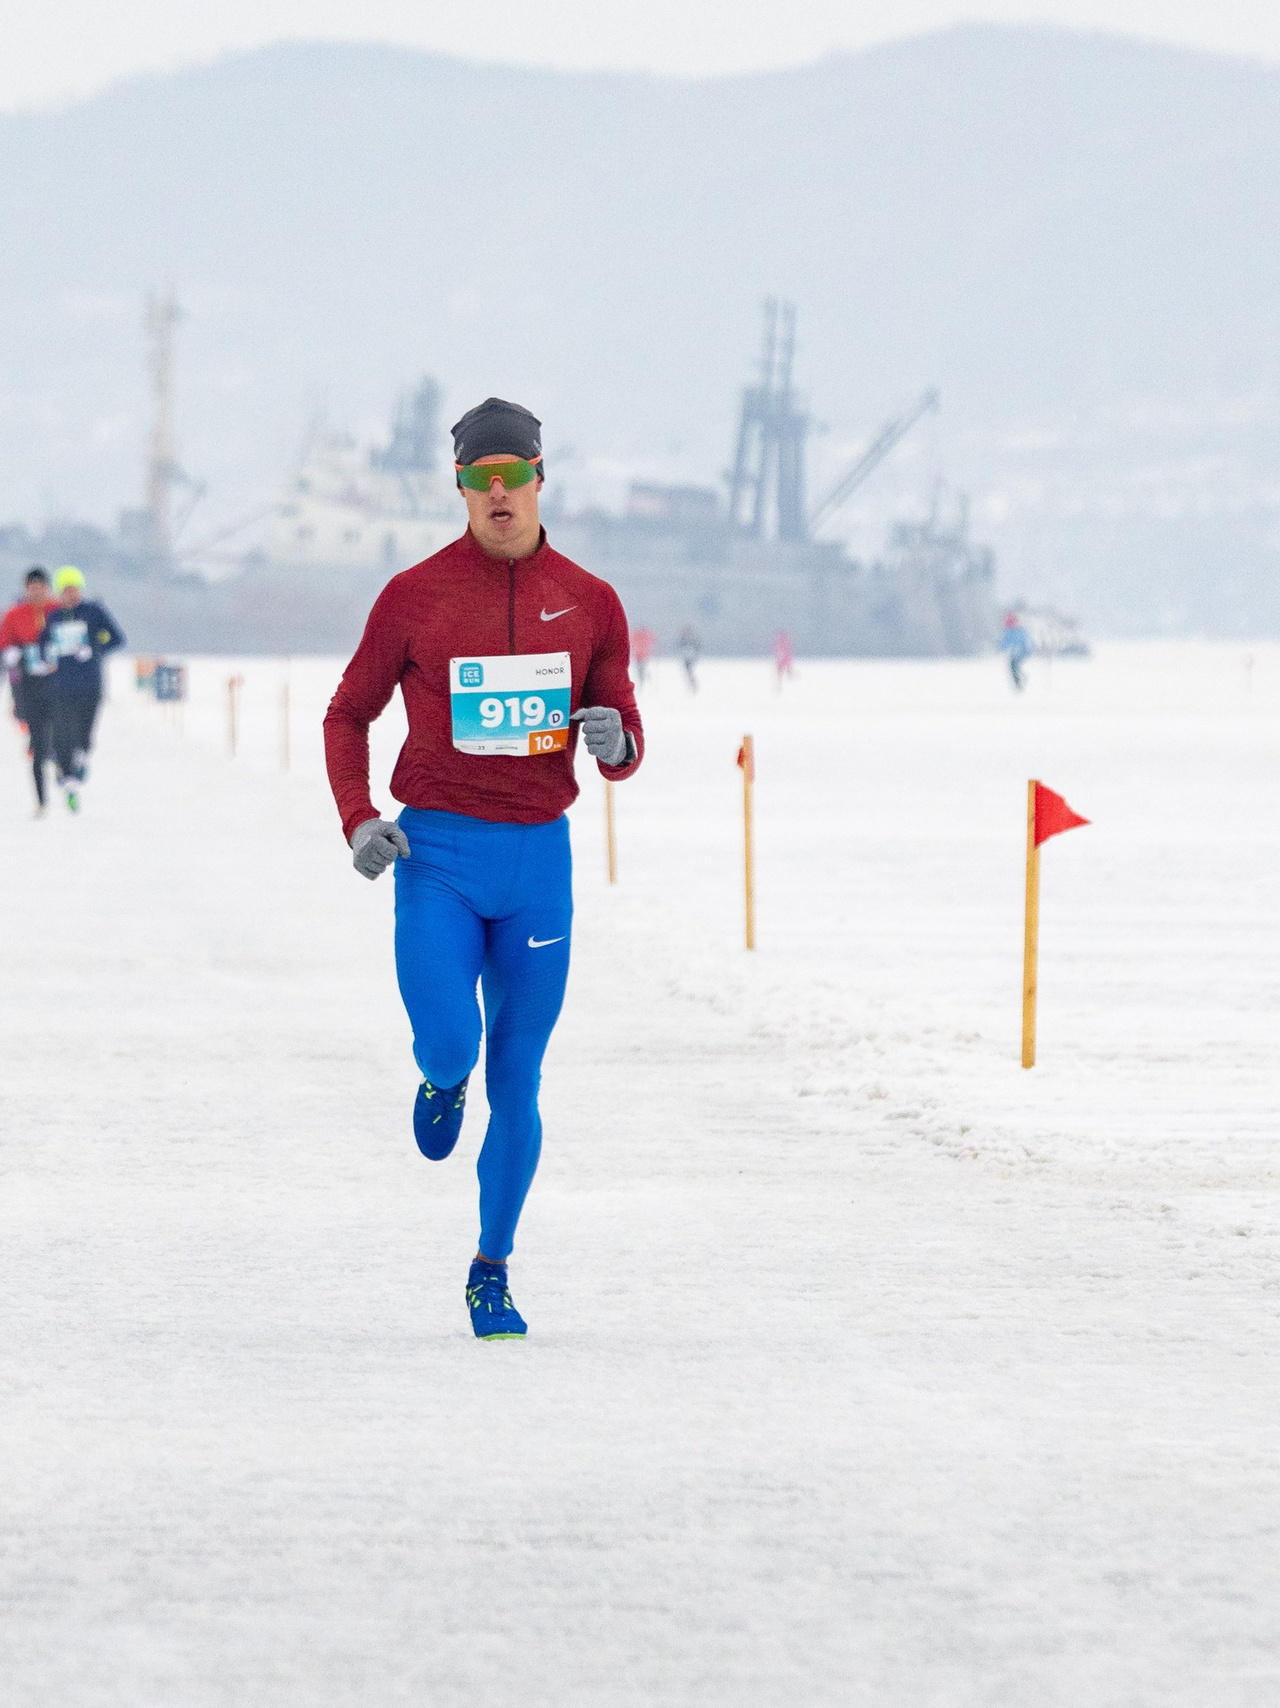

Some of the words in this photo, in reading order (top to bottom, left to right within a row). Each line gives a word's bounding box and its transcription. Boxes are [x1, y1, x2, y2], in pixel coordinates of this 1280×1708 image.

[535, 667, 565, 676] HONOR
[479, 696, 546, 728] 919
[552, 713, 561, 724] D
[535, 735, 554, 751] 10
